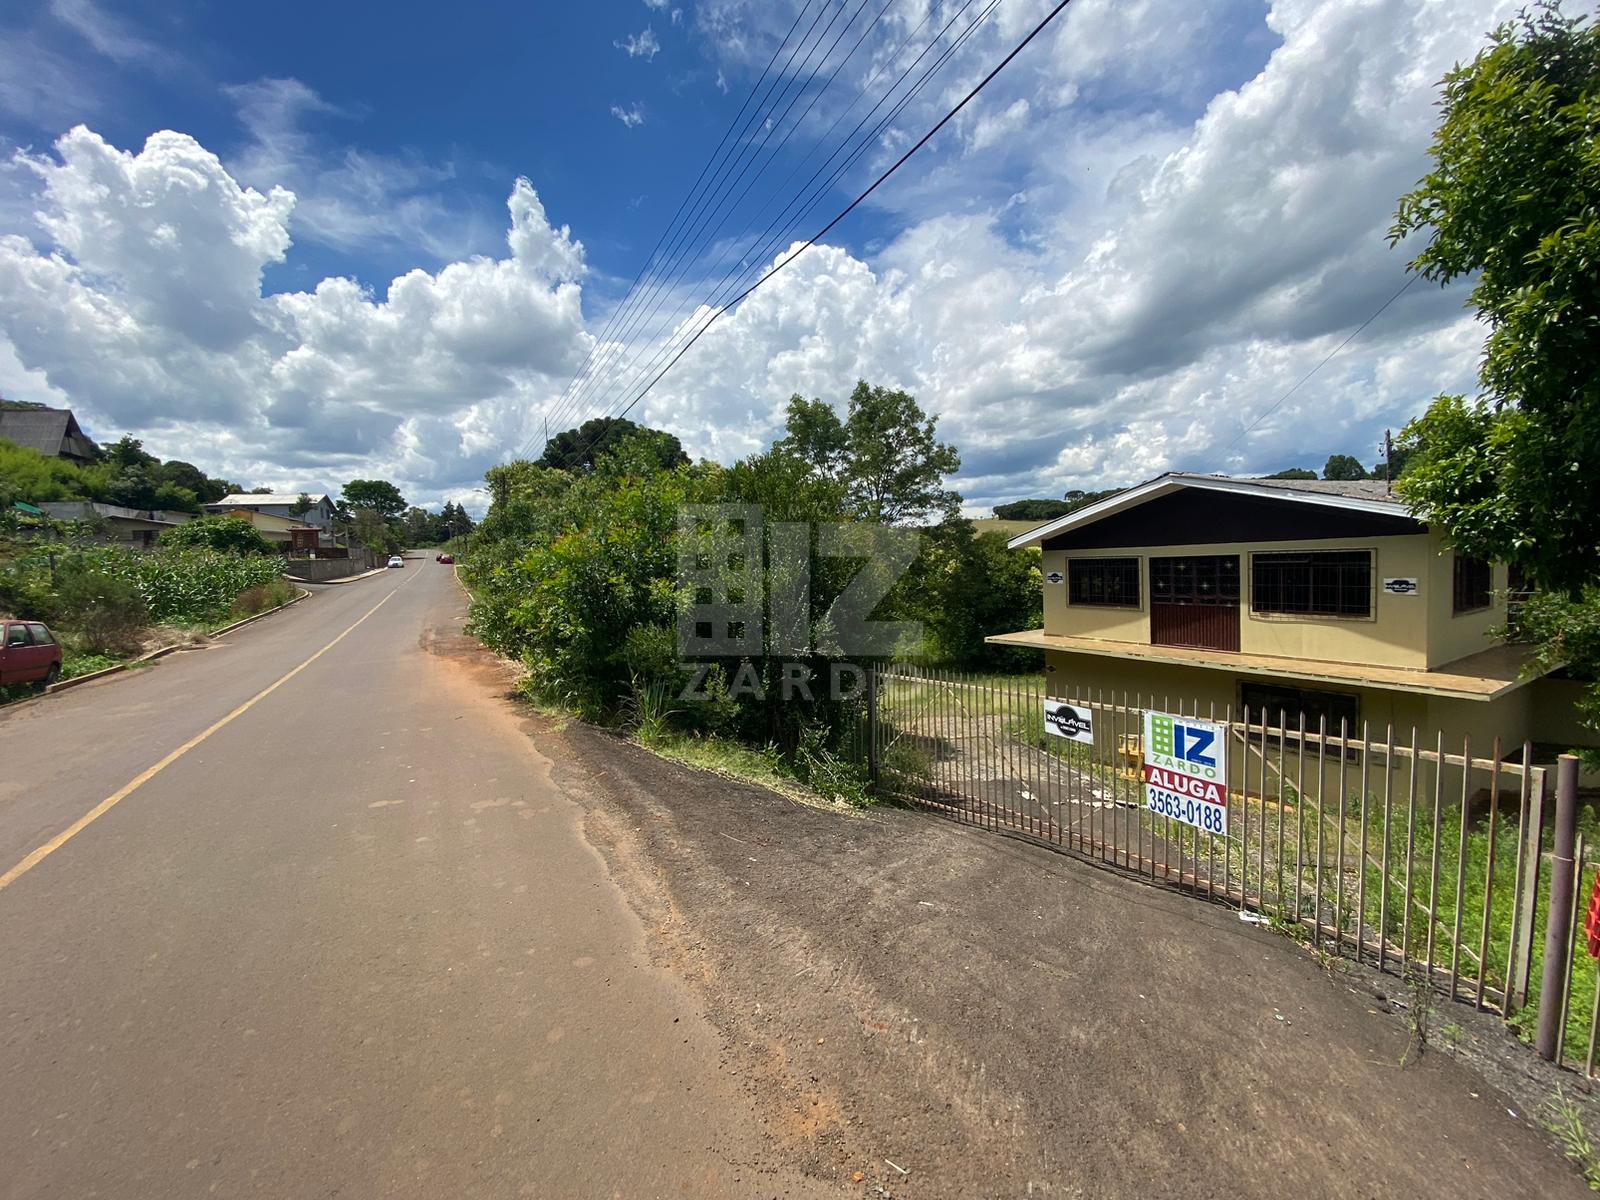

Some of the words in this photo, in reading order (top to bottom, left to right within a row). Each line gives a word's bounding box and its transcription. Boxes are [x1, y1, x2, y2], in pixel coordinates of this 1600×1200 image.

[1152, 752, 1217, 779] ZARDO
[1174, 723, 1217, 768] IZ
[1149, 767, 1221, 803] ALUGA
[1149, 787, 1223, 833] 3563-0188
